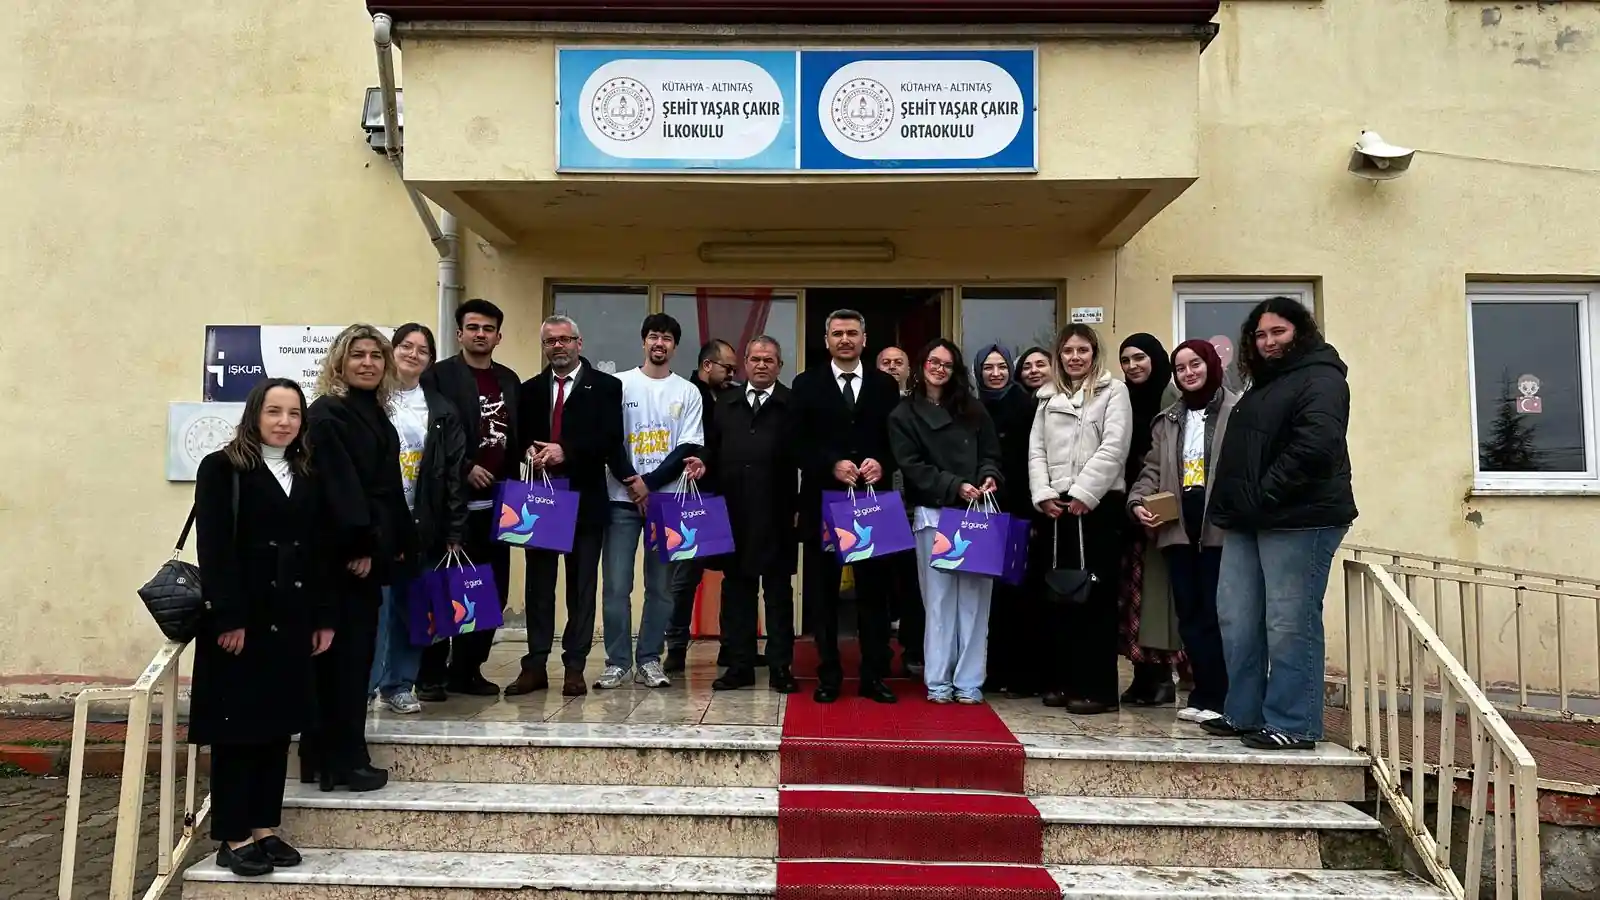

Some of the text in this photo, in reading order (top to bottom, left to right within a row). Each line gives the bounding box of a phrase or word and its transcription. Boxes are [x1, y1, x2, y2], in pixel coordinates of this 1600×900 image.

[662, 81, 704, 92] KÜTAHYA
[712, 82, 753, 94] ALTINTAŞ
[900, 82, 942, 92] KÜTAHYA
[950, 82, 992, 94] ALTINTAŞ
[662, 98, 697, 119] ŞEHİT
[702, 101, 740, 119] YAŞAR
[742, 101, 780, 119] ÇAKIR
[900, 98, 935, 119] ŞEHİT
[939, 101, 978, 119] YAŞAR
[981, 101, 1019, 119] ÇAKIR
[662, 121, 724, 138] İLKOKULU
[900, 124, 974, 139] ORTAOKULU
[302, 335, 312, 343] BU
[279, 346, 306, 354] TOPLUM
